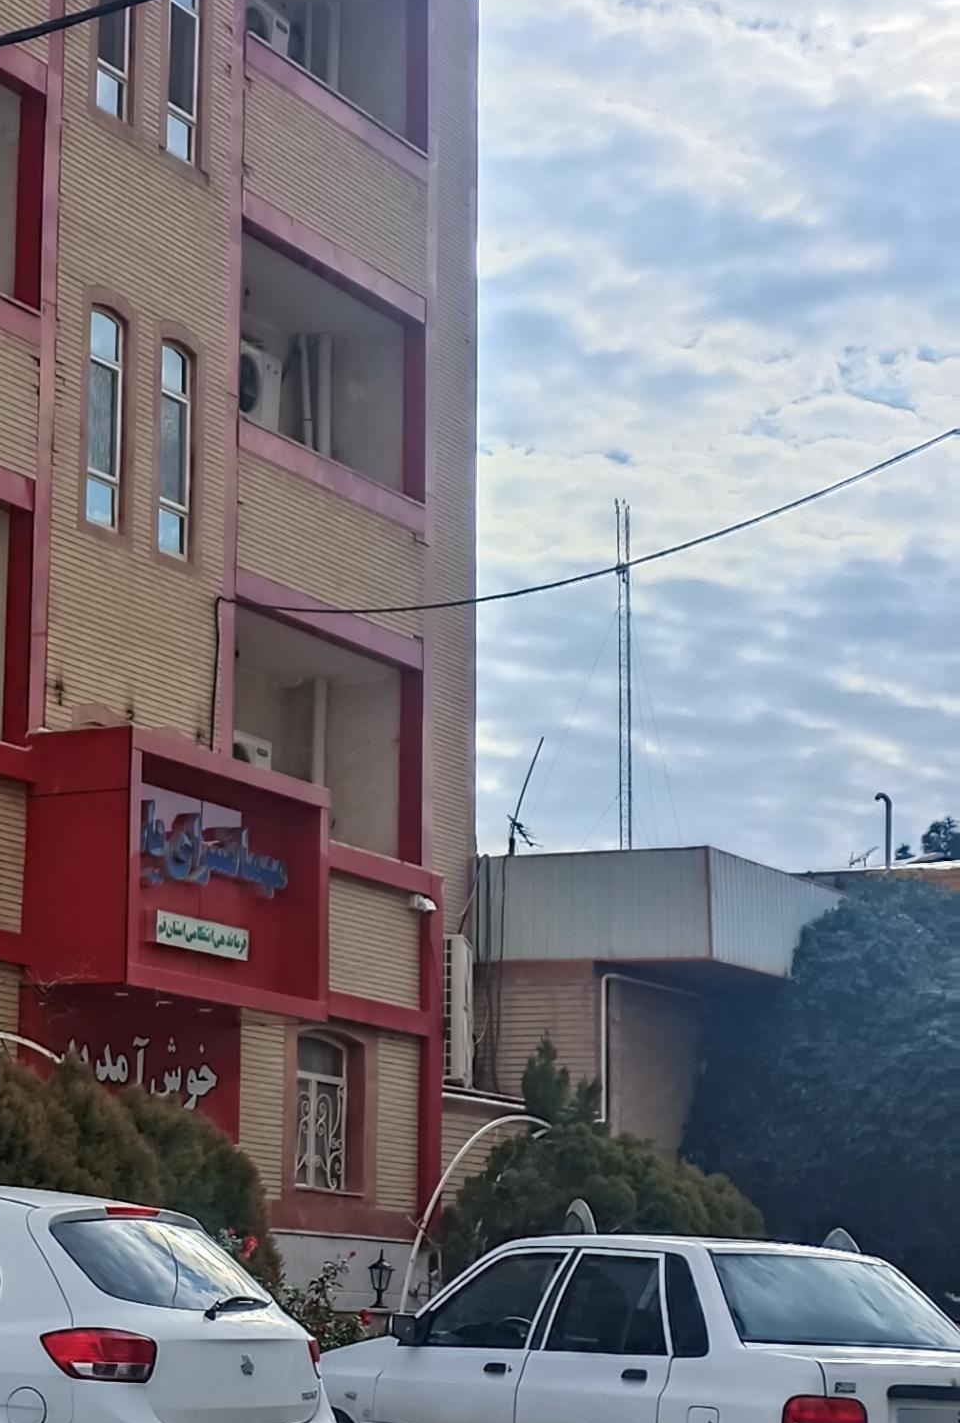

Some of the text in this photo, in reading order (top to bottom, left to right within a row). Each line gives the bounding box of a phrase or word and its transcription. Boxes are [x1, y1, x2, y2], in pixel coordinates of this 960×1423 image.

[166, 920, 187, 939] استان
[185, 925, 215, 944] انتظامی
[213, 931, 248, 955] فرماندهی
[62, 1035, 218, 1111] خوش آمد
